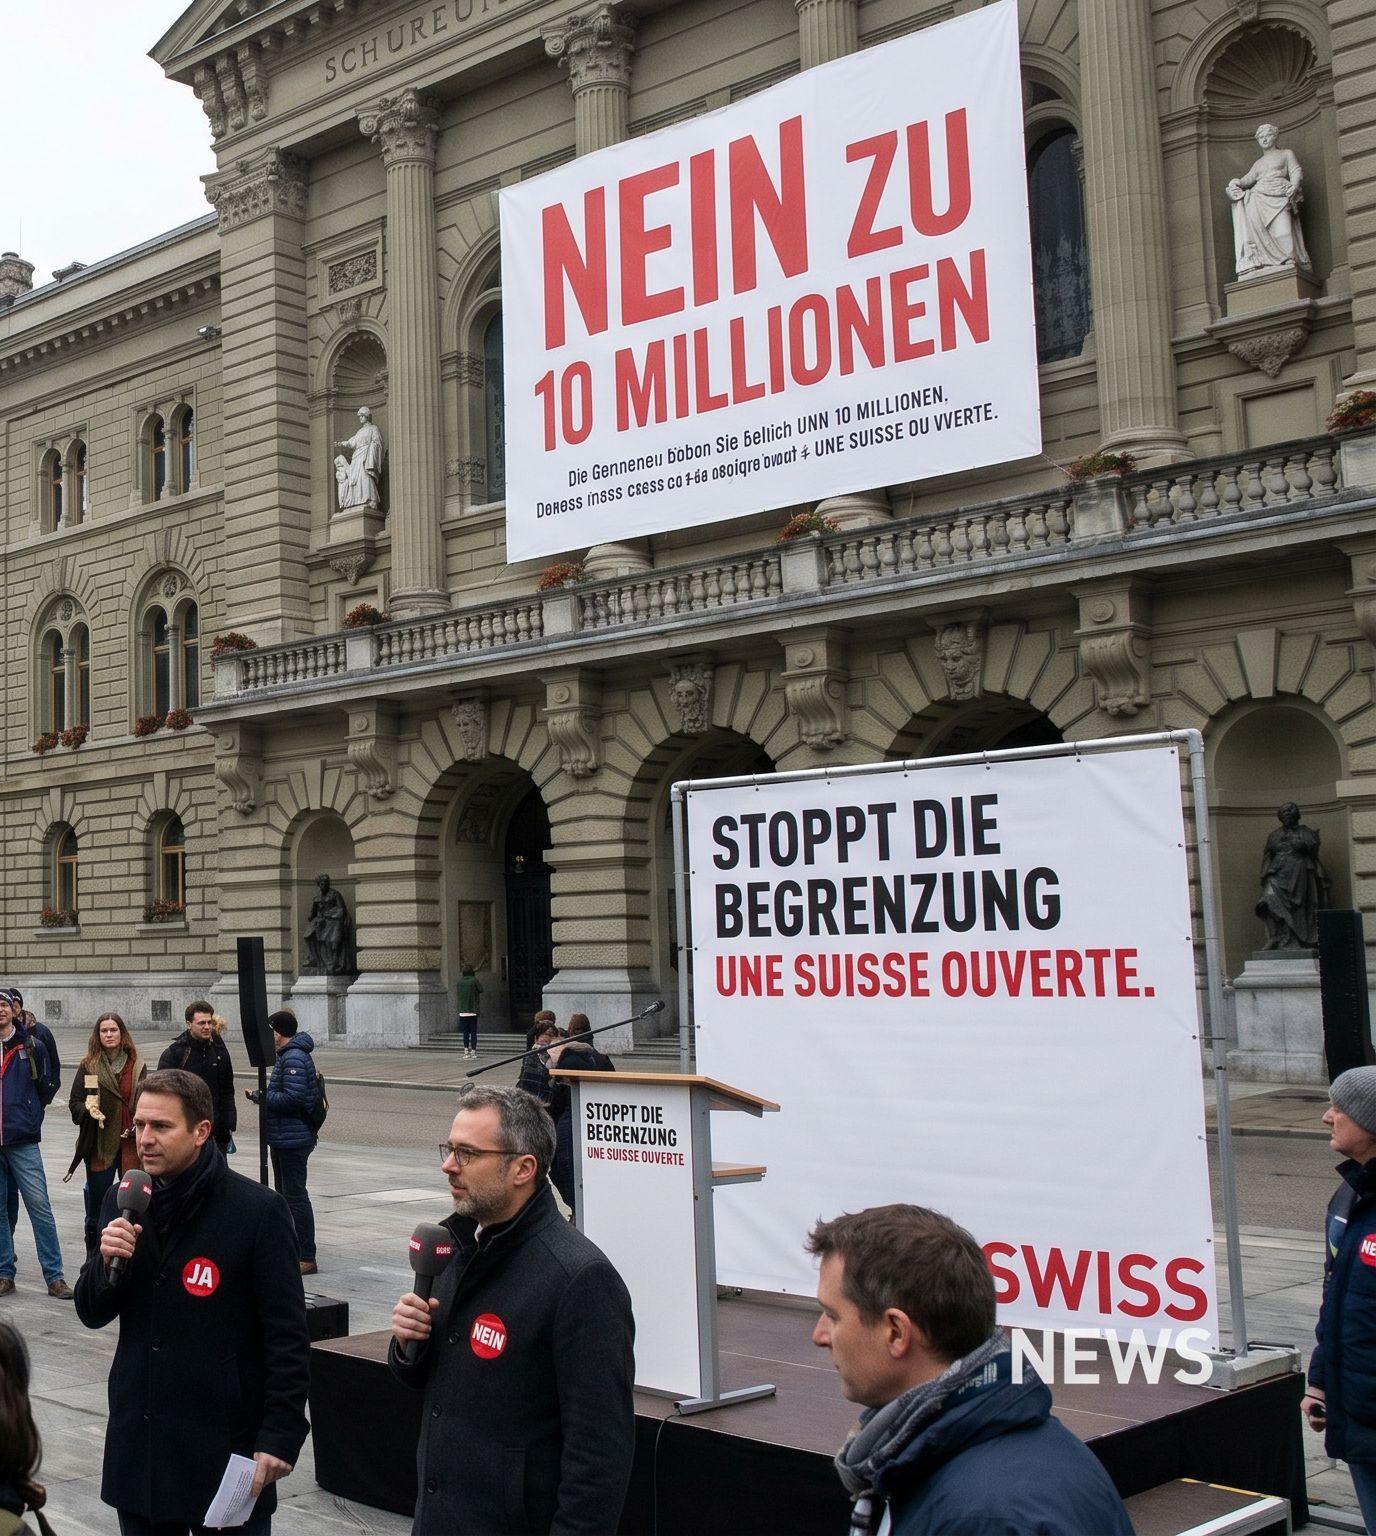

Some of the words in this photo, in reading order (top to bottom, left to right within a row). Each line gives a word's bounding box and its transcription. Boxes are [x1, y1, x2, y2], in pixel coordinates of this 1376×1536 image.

[542, 115, 809, 350] NEIN
[845, 108, 972, 259] ZU
[535, 360, 593, 452] 10
[615, 248, 990, 432] MILLIONEN
[568, 468, 588, 487] Die
[716, 434, 738, 454] Sie
[797, 411, 829, 434] UNN
[835, 406, 851, 425] 10
[815, 435, 845, 457] UNE
[849, 422, 904, 450] SUISSE
[909, 416, 929, 437] OU
[711, 801, 898, 871] STOPPT
[914, 793, 1001, 860] DIE
[715, 866, 1062, 939] BEGRENZUNG
[715, 954, 784, 998] UNE
[793, 951, 928, 998] SUISSE
[941, 947, 1156, 998] OUVERTE.
[586, 1102, 637, 1123] STOPPT
[641, 1105, 663, 1124] DIE
[587, 1123, 677, 1147] BEGRENZUNG
[587, 1146, 605, 1159] UNE
[607, 1148, 640, 1162] SUISSE
[641, 1150, 685, 1166] OUVERTE
[186, 1263, 213, 1288] JA
[981, 1241, 1208, 1322] SWISS
[472, 1322, 505, 1351] NEIN
